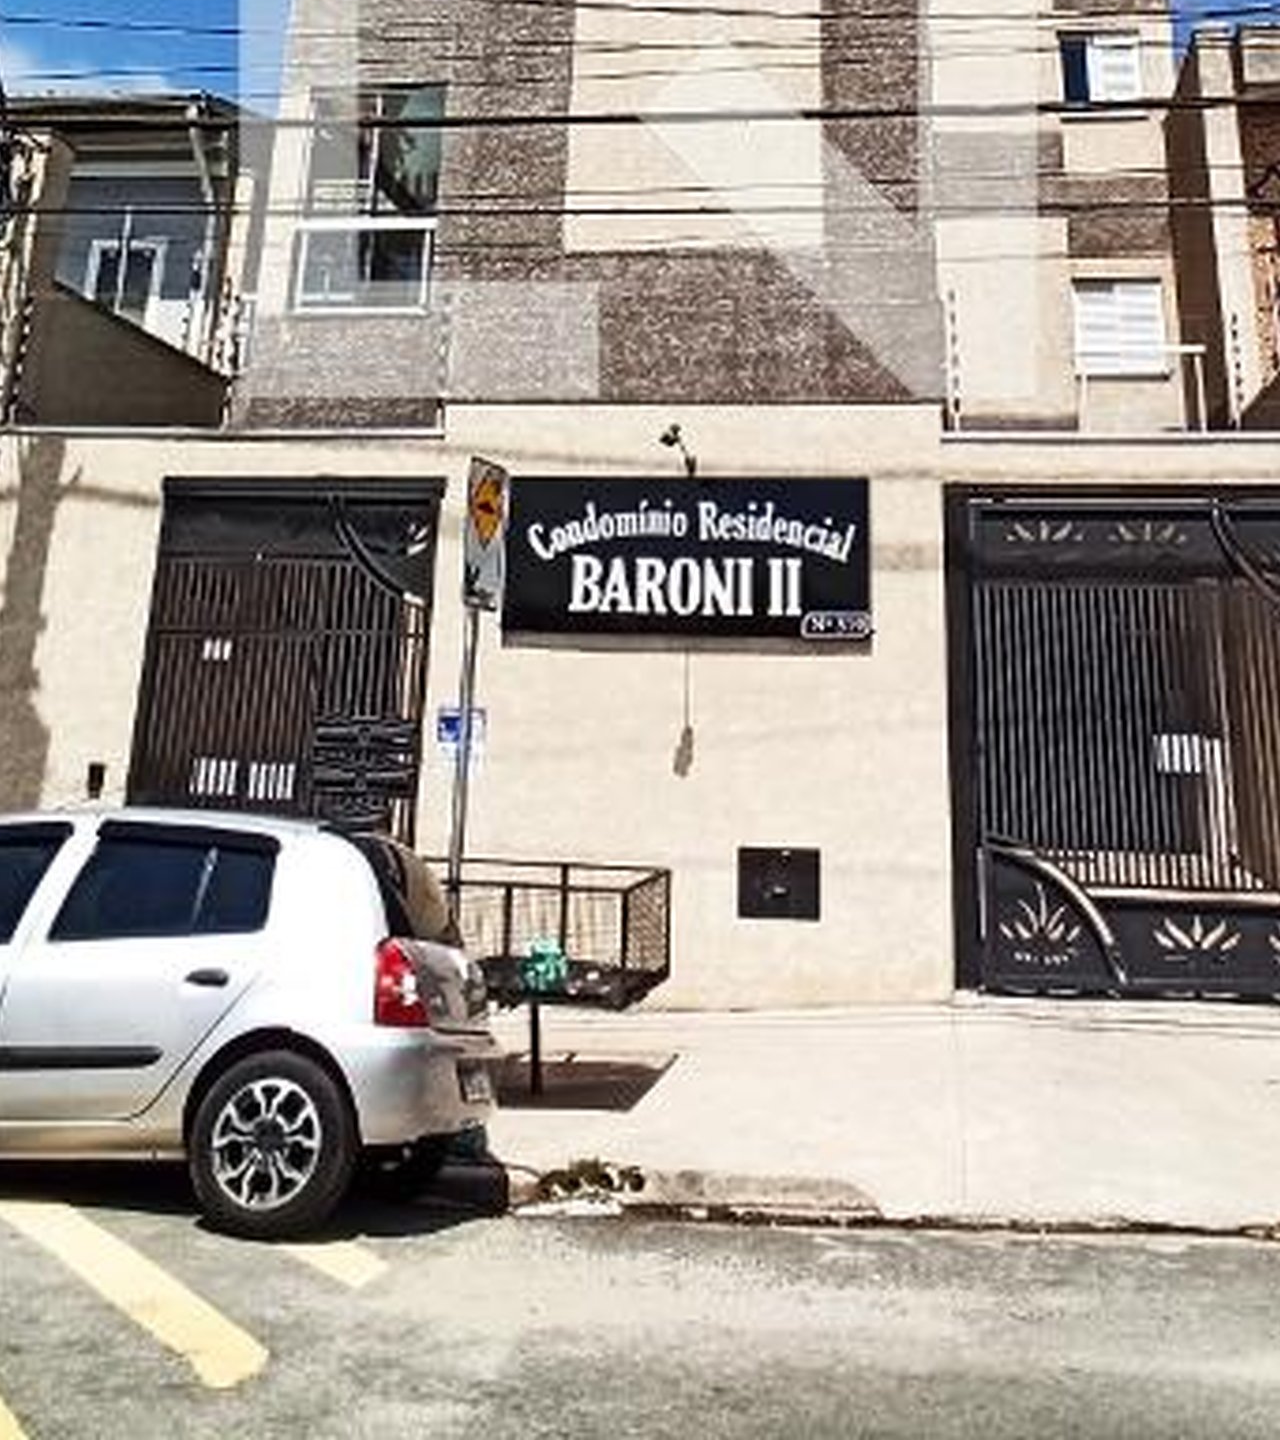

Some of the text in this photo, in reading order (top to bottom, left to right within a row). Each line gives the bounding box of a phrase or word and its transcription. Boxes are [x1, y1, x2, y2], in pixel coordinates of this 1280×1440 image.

[528, 499, 856, 562] Condomínio Residencial
[568, 554, 803, 616] BARONI II
